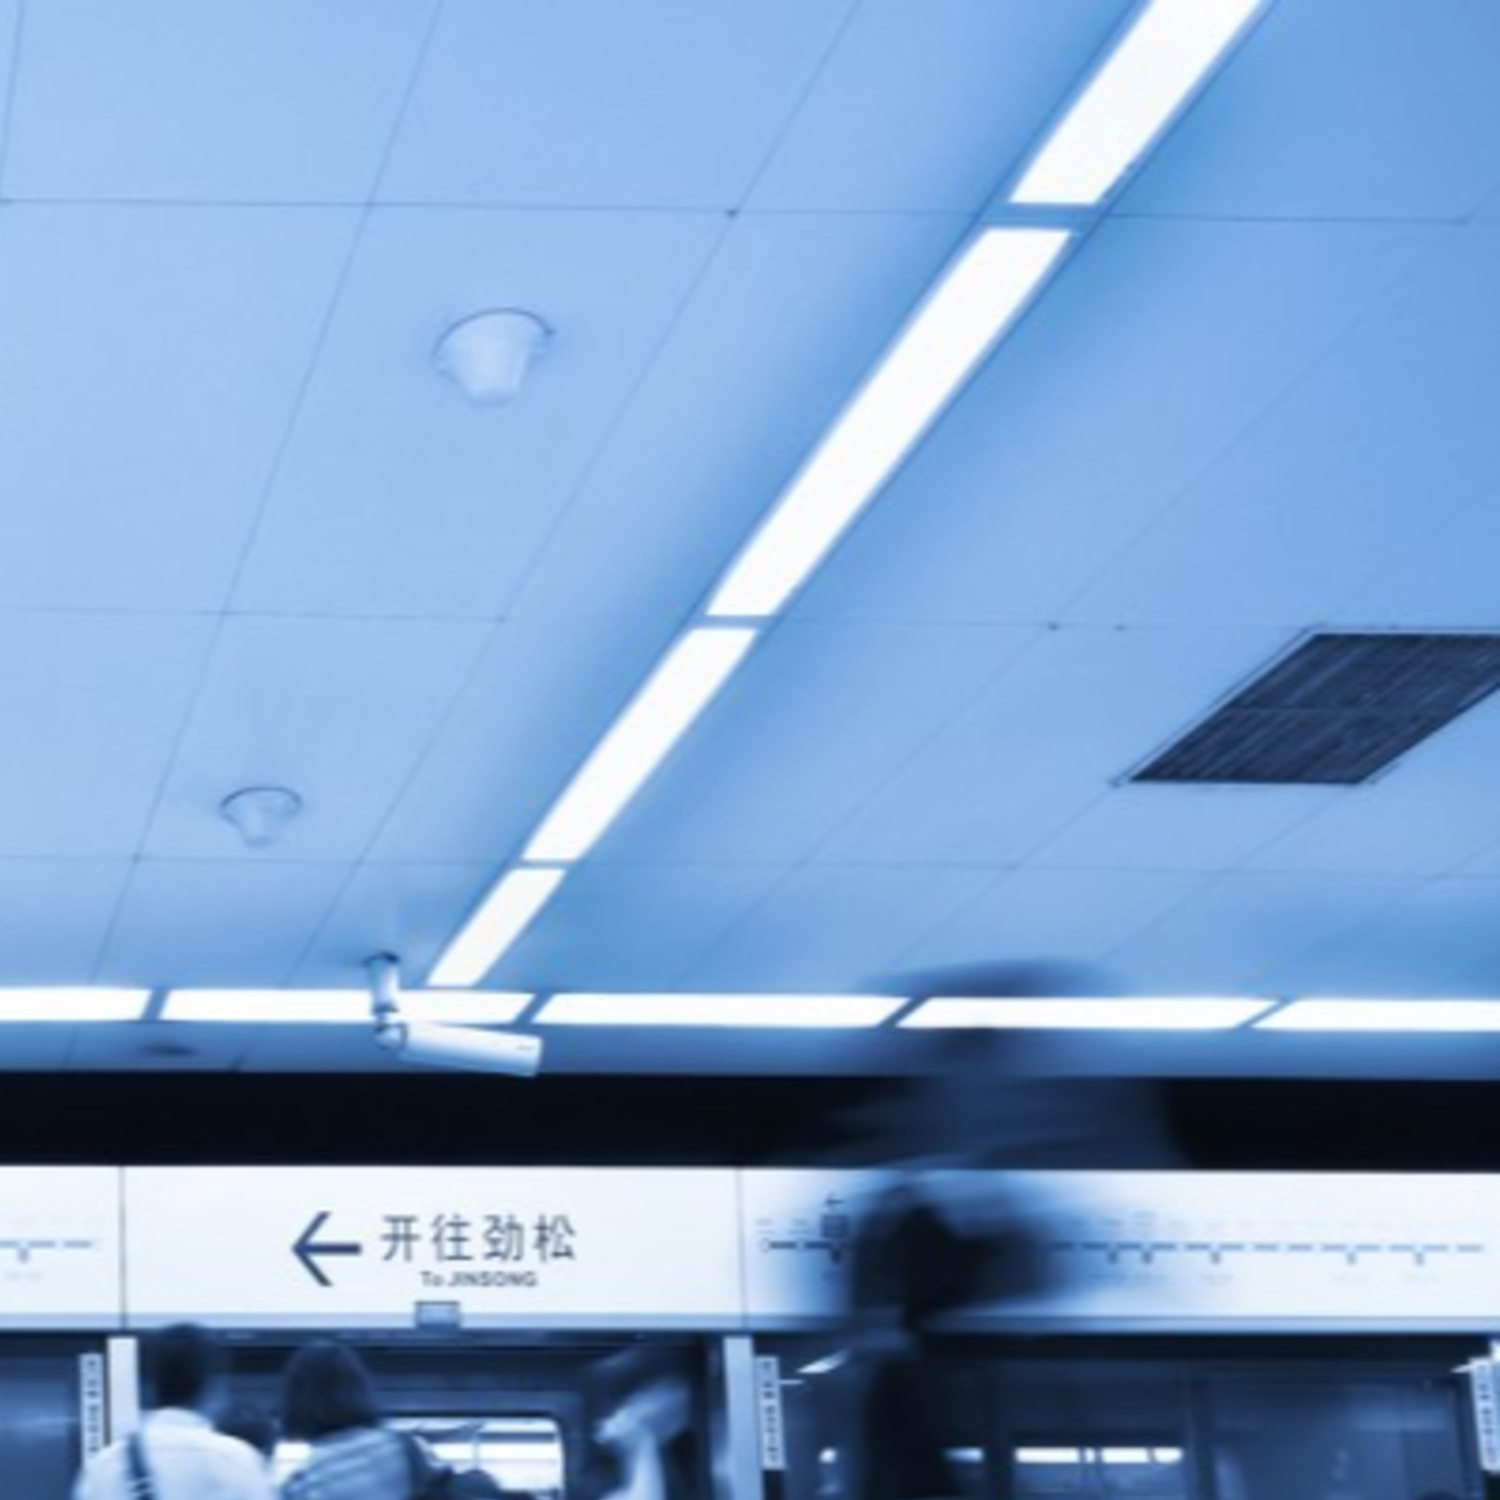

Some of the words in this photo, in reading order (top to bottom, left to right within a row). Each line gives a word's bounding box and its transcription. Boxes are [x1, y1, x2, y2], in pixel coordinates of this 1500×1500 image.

[380, 1213, 575, 1262] 开往劲松
[420, 1270, 445, 1287] To
[448, 1270, 538, 1288] JINSONG
